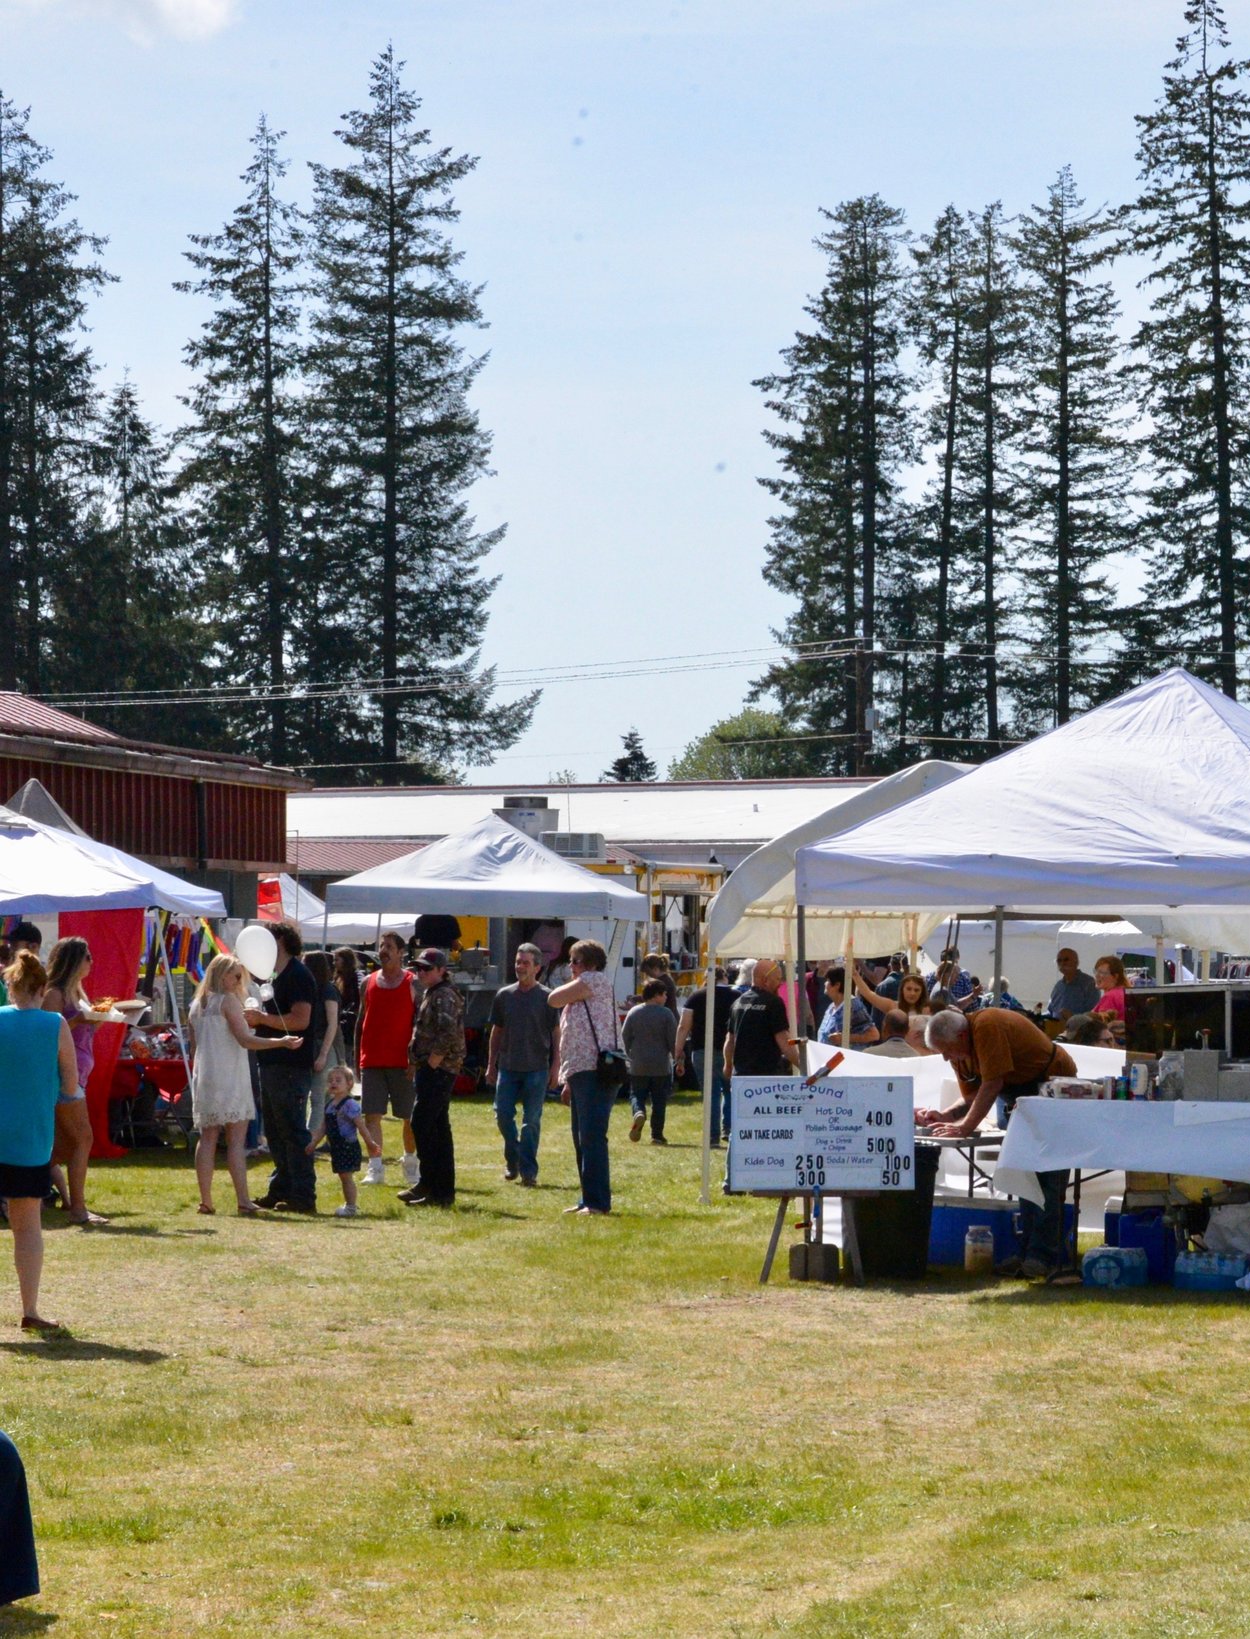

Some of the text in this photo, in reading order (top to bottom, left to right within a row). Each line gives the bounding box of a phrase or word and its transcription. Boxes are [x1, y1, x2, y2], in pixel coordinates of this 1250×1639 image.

[744, 1083, 795, 1099] Quarter
[800, 1082, 844, 1099] Pound
[753, 1106, 803, 1115] ALL BEEF
[815, 1107, 853, 1116] Hot Dog
[828, 1116, 840, 1124] OR
[866, 1110, 893, 1126] 400
[739, 1128, 794, 1140] CAN TAKE CARDS
[805, 1124, 863, 1133] Polish Sausage
[815, 1138, 829, 1146] Dog
[867, 1138, 896, 1153] 500
[744, 1156, 785, 1167] Kids Dog
[795, 1154, 824, 1170] 250
[884, 1155, 911, 1170] 100
[798, 1170, 826, 1186] 300
[882, 1170, 900, 1186] 50
